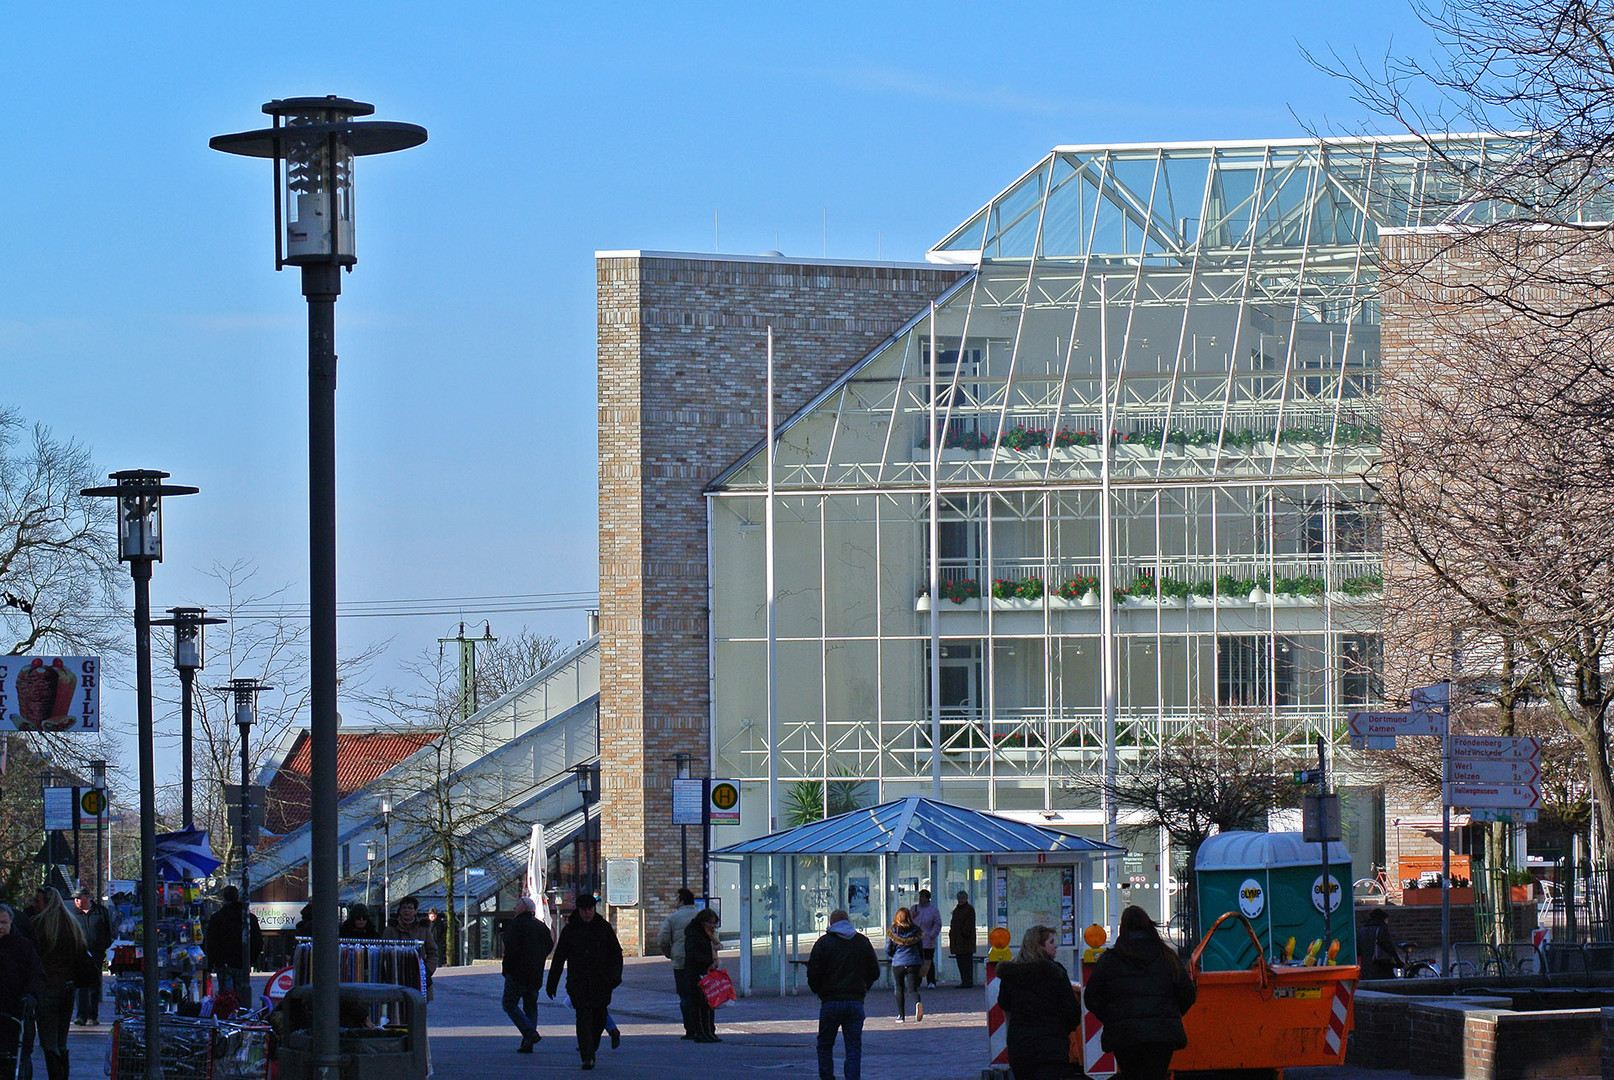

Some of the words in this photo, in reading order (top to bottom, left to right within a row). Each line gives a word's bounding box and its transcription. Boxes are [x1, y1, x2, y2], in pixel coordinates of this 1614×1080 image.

[81, 660, 96, 728] GRILL
[1368, 715, 1407, 723] Dortmund
[1455, 739, 1502, 748] Fröndenberg
[1454, 748, 1502, 756] Holzwickede
[719, 789, 731, 804] H
[1454, 787, 1499, 796] Hellwegmuseum
[1240, 888, 1262, 899] OLYMP
[1314, 884, 1339, 895] OLMP
